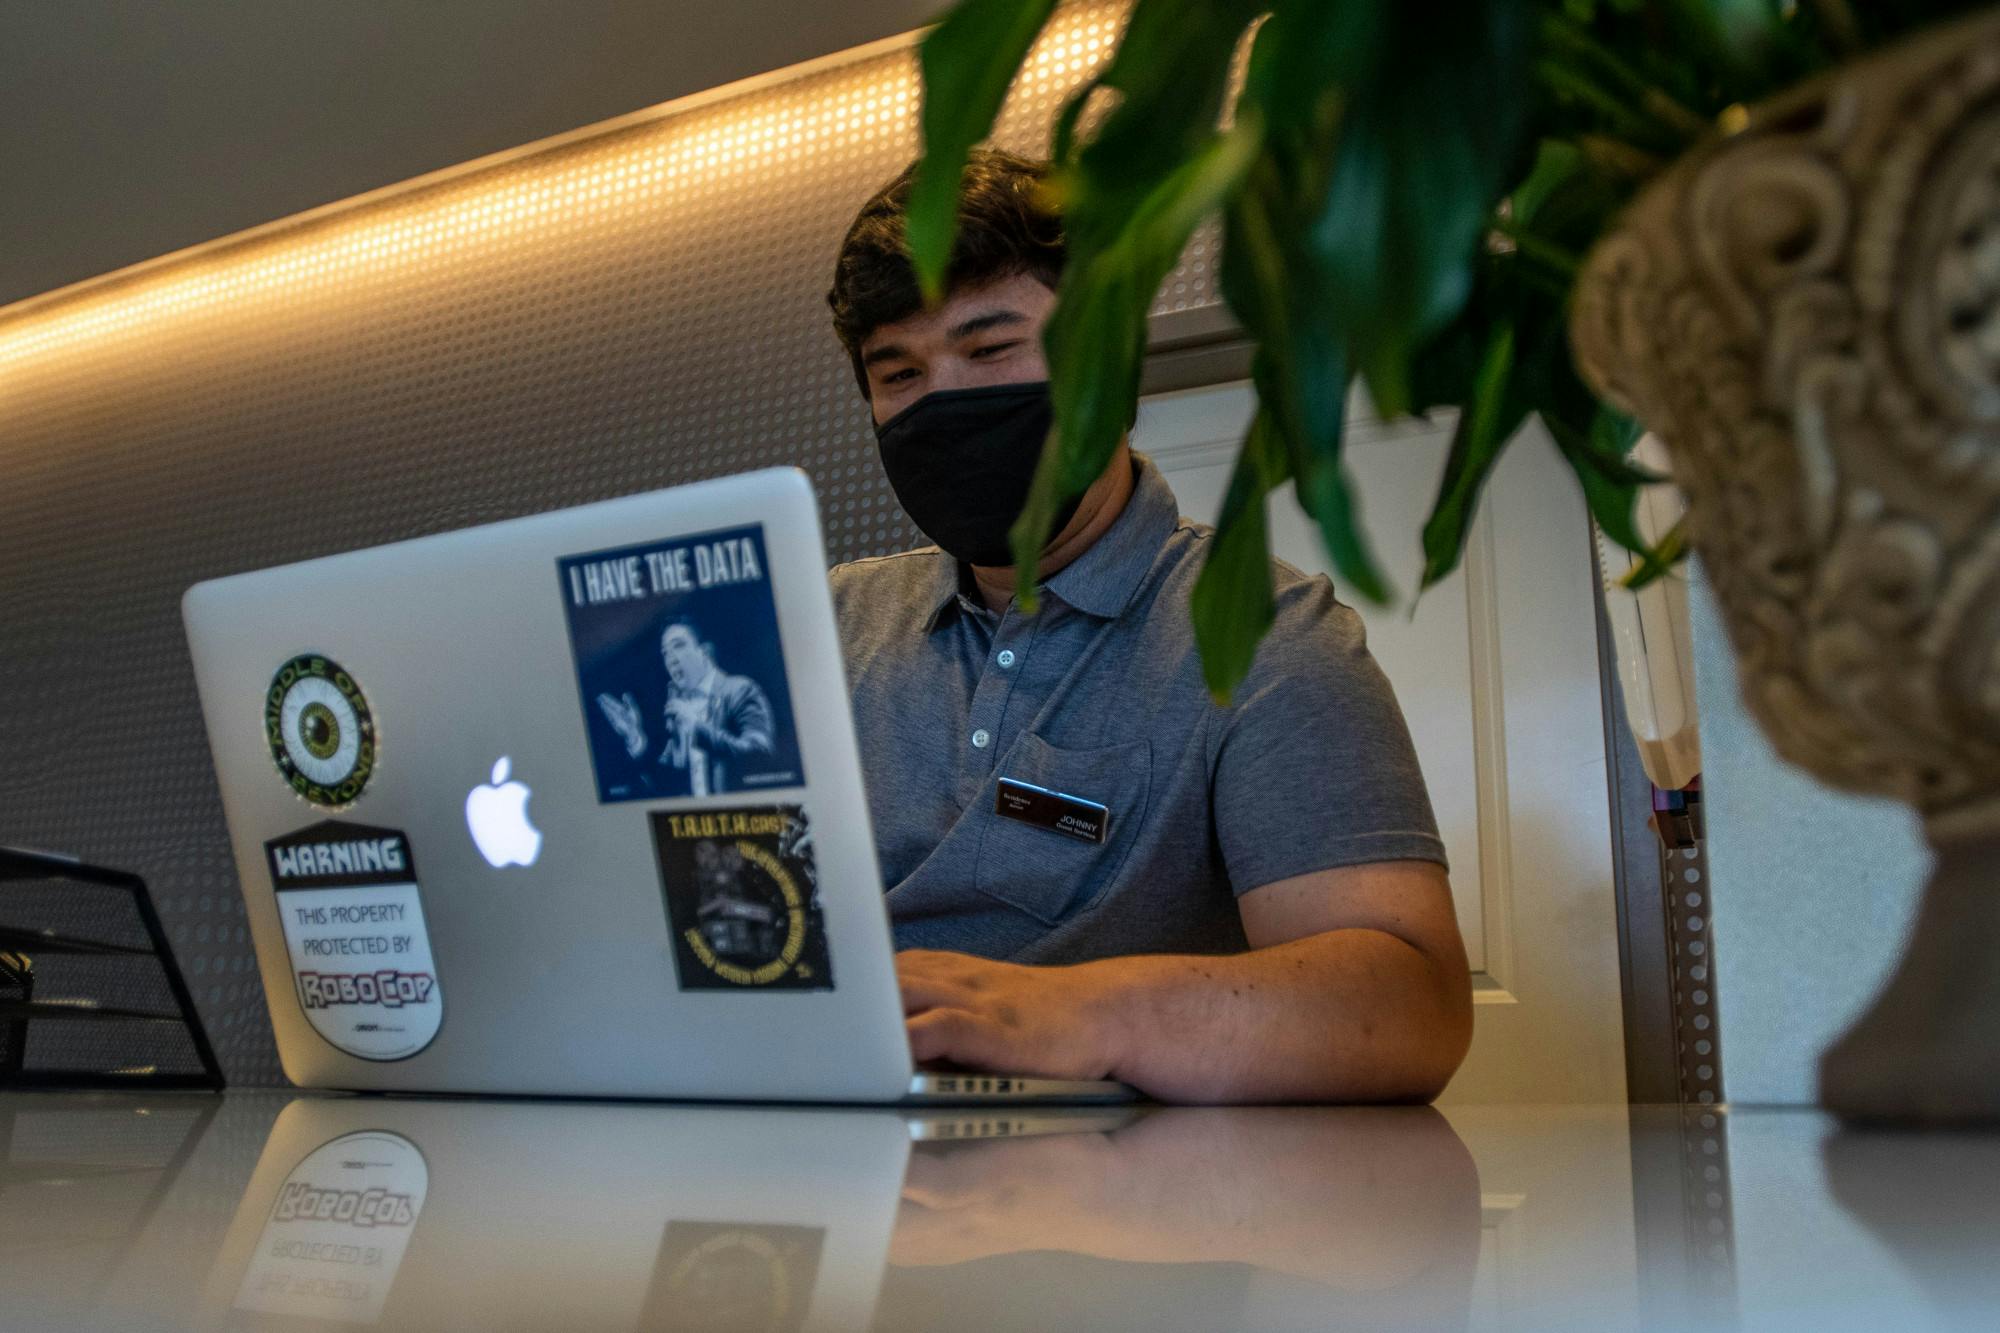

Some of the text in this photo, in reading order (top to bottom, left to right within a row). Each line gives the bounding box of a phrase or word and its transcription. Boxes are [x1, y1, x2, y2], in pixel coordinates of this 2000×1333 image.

[569, 537, 762, 606] I HAVE THE DATA
[1061, 815, 1098, 832] JOHNNY
[275, 838, 403, 877] WARNING
[296, 903, 405, 925] THIS PROPERTY
[304, 936, 412, 955] PROTECTED BY
